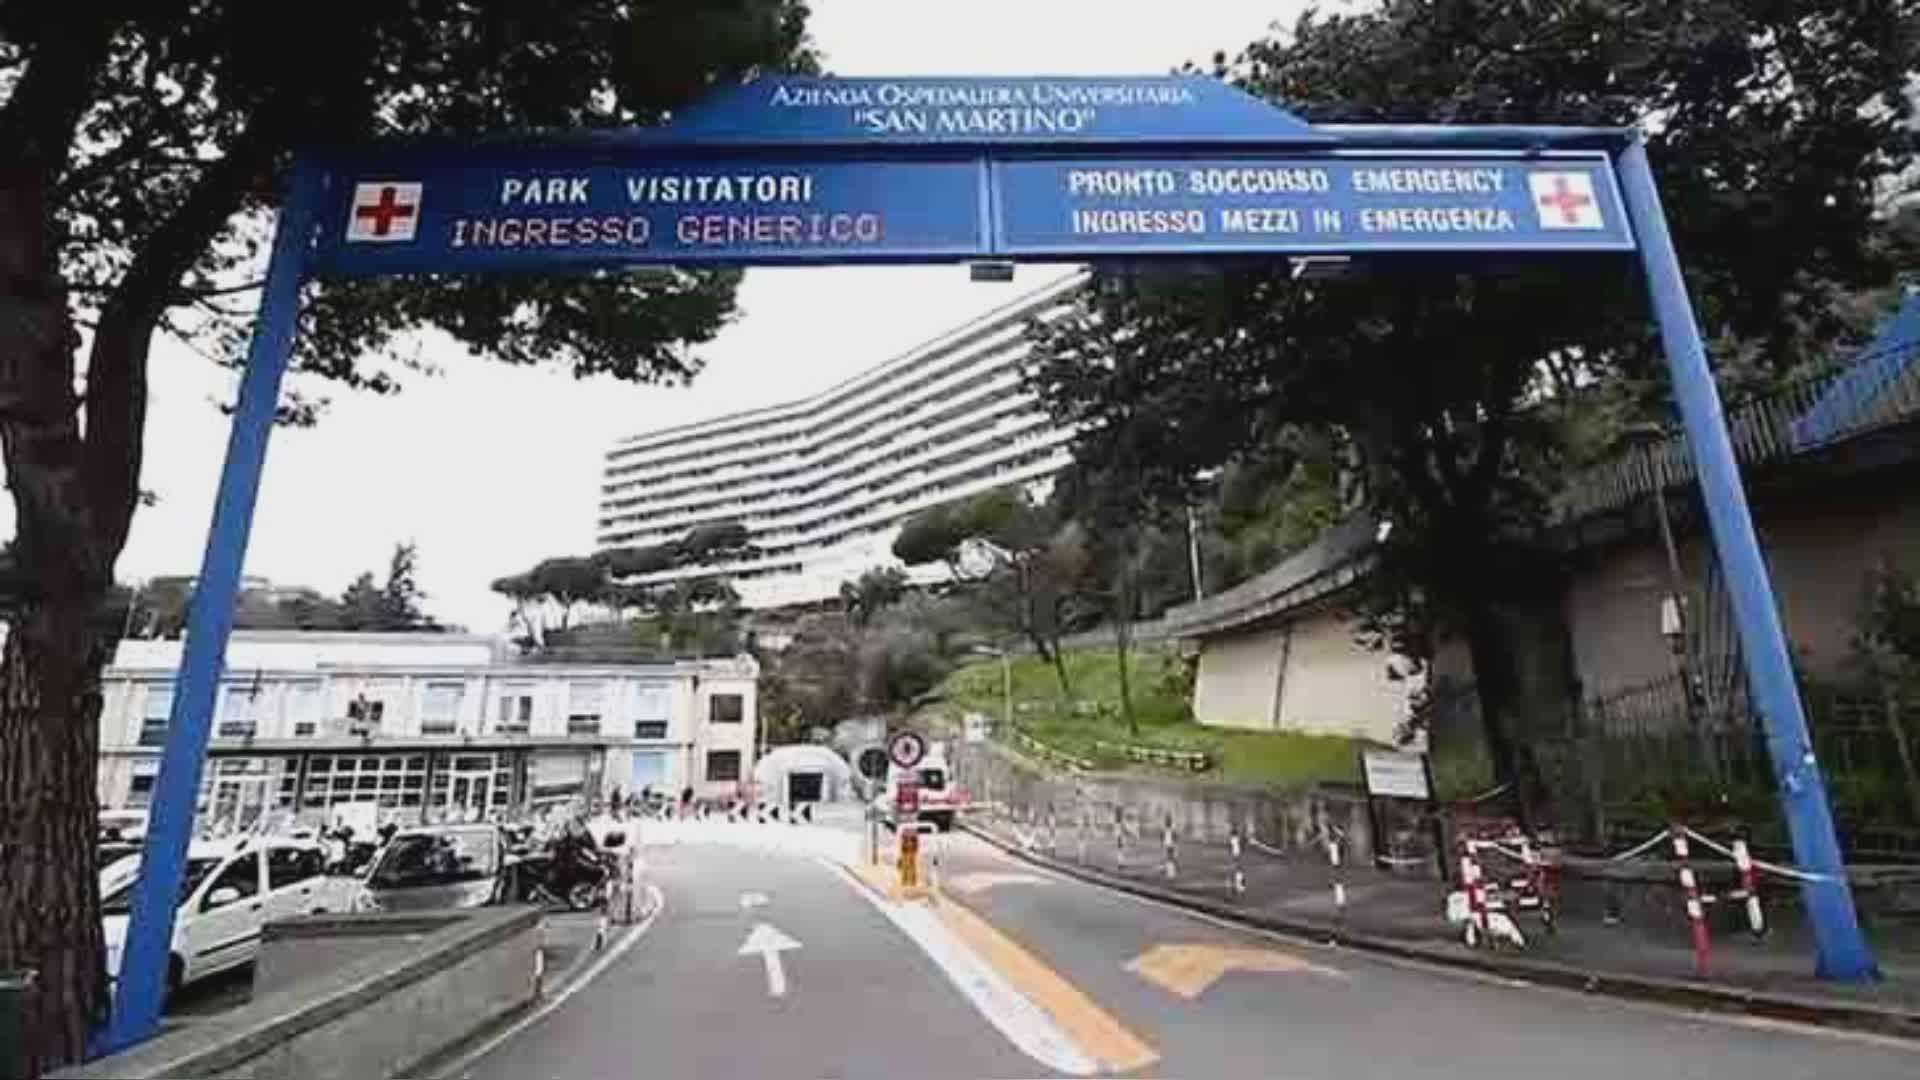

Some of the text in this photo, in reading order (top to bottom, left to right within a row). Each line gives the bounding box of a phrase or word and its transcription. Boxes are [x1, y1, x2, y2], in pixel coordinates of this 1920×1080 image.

[769, 86, 874, 106] AZIENDA
[854, 107, 1096, 132] "SAN MARTINO"
[501, 175, 812, 204] PARK VISITATORI
[1068, 167, 1504, 195] PRONTO SOCCORSO EMERGENCY
[451, 212, 883, 247] INGRESSO GENERICO
[1072, 206, 1515, 234] INGRESSO MEZZI IN EMERGENZA
